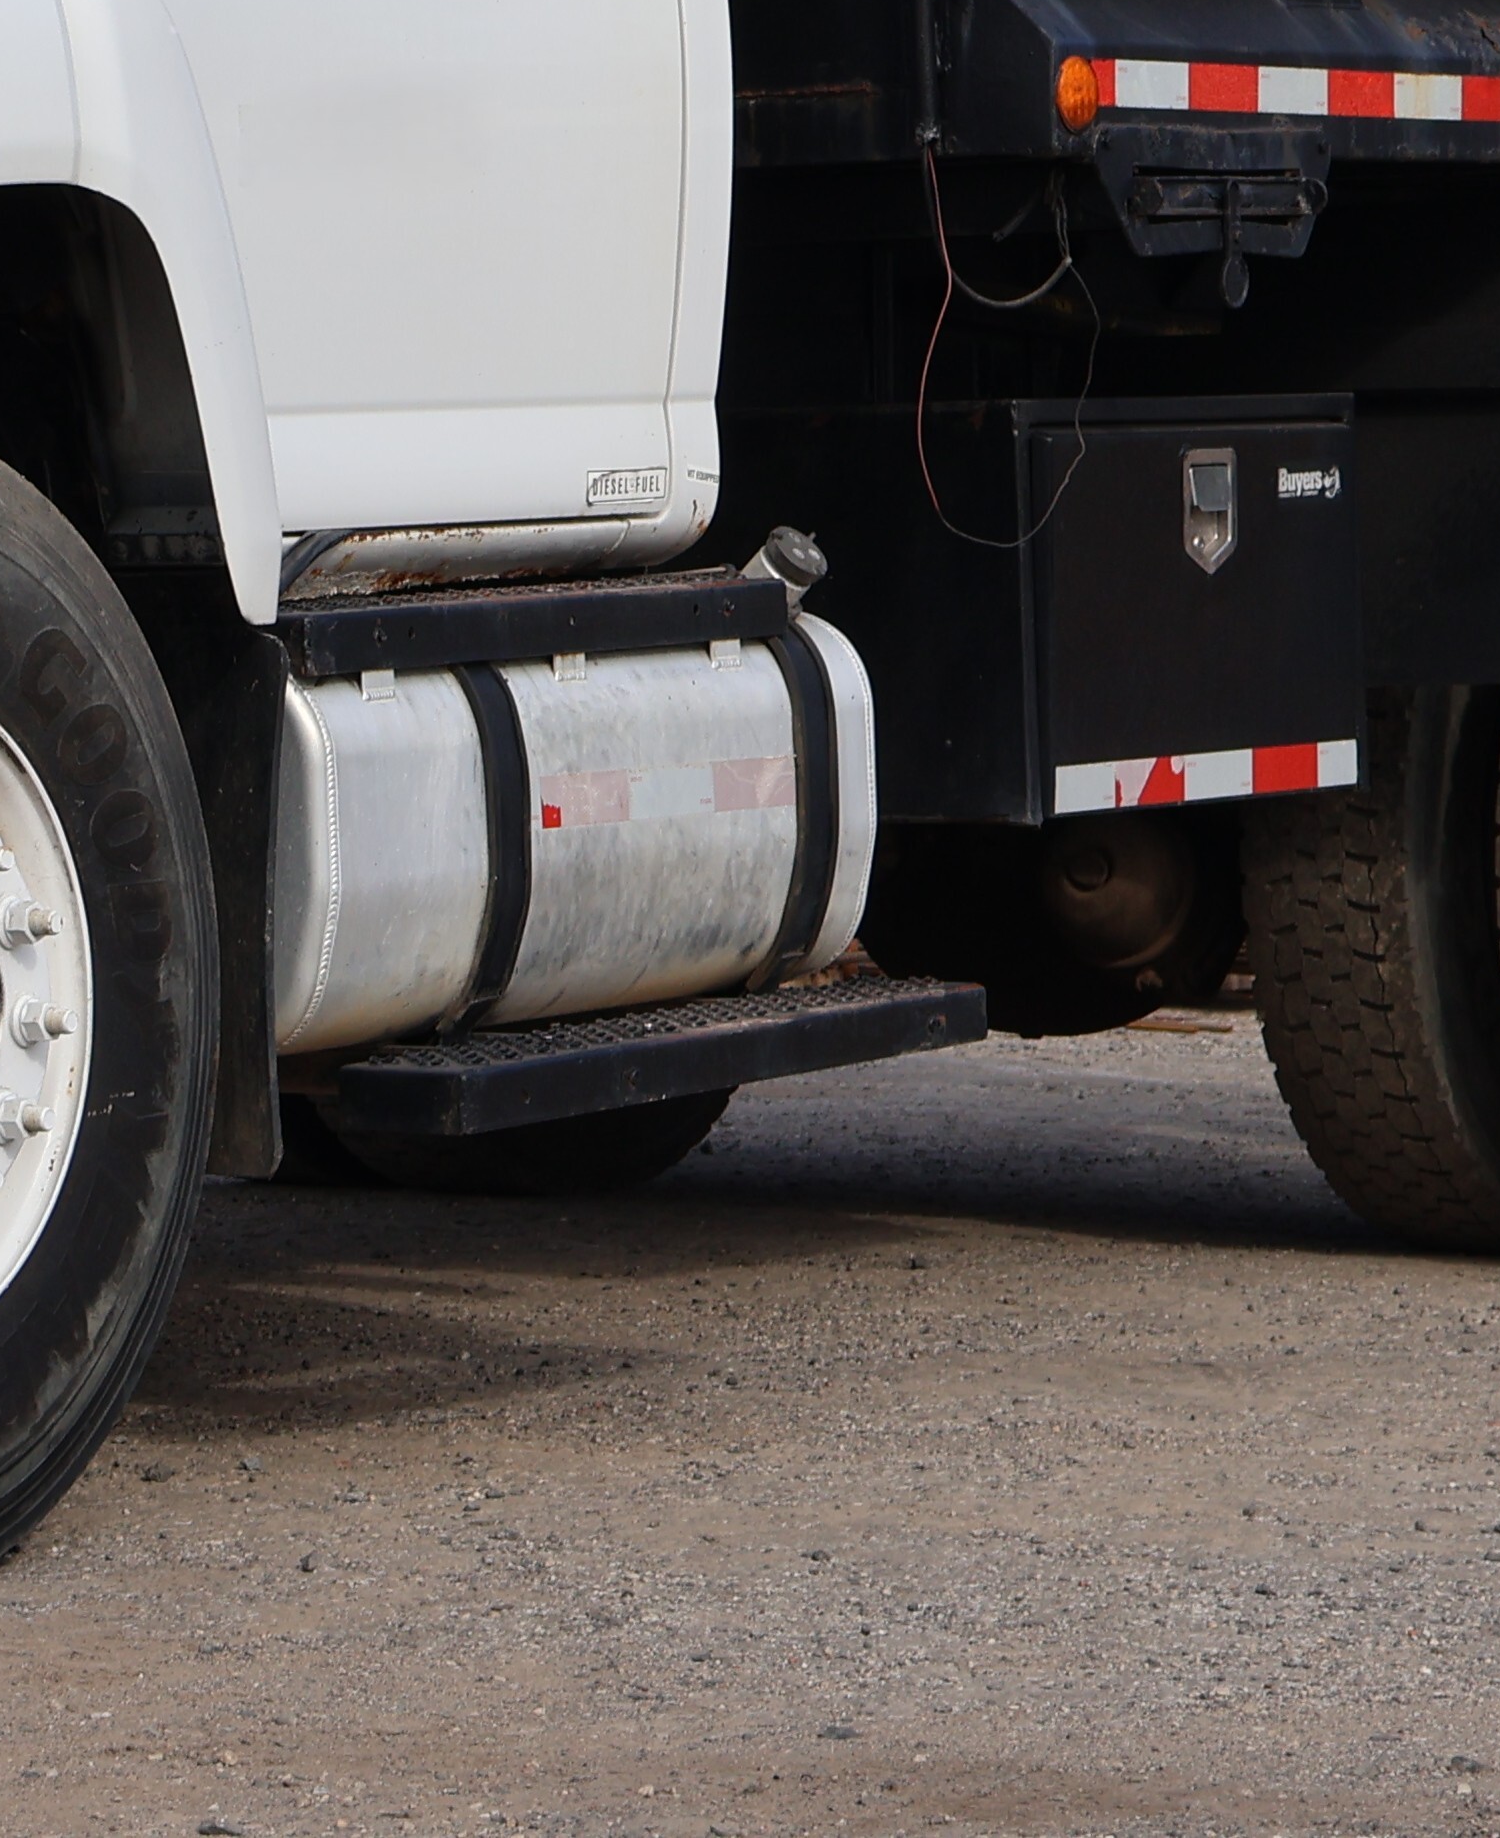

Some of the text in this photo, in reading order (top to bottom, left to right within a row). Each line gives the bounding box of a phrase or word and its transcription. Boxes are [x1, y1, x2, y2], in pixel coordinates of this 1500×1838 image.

[592, 475, 661, 497] DIESEL FUEL
[1278, 467, 1323, 497] Buyers
